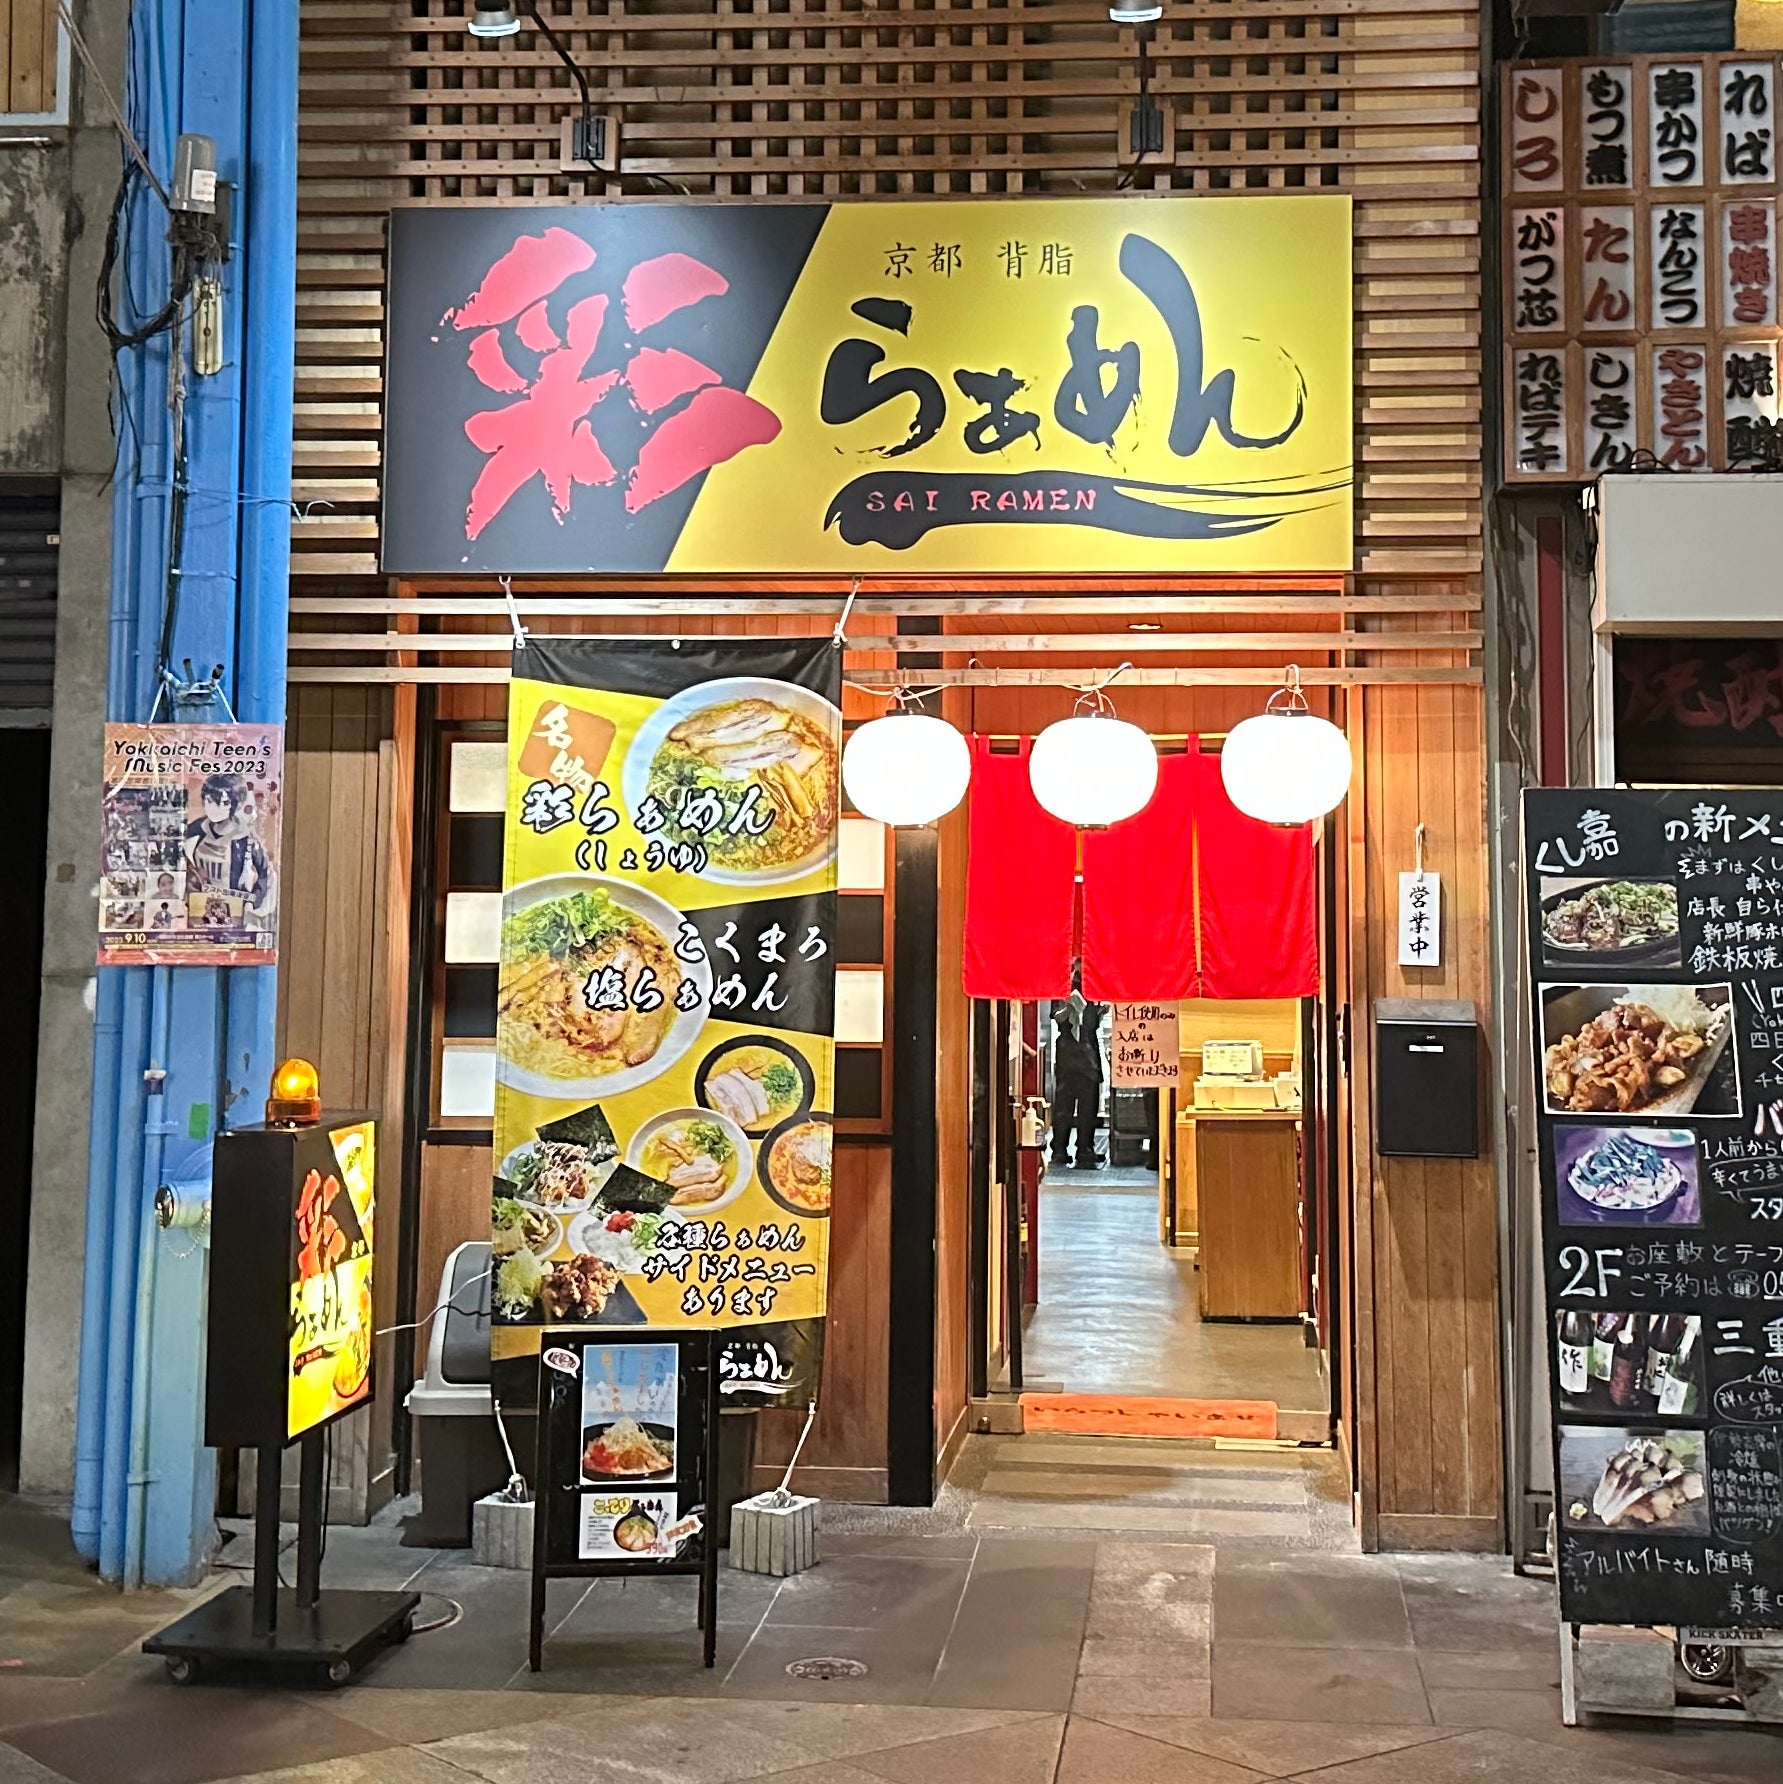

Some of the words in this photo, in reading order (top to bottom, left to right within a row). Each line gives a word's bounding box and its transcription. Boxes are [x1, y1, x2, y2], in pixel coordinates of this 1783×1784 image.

[1513, 78, 1558, 181] しろ
[1585, 70, 1627, 184] もつ煮
[1654, 69, 1696, 181] 串かつ
[1724, 69, 1770, 177] れば
[884, 241, 962, 278] 京都
[996, 240, 1077, 278] 背脂
[1518, 212, 1559, 327] がつ芯
[1583, 218, 1629, 322] たん
[1660, 210, 1698, 324] なんこつ
[1729, 206, 1769, 322] 串焼き
[431, 226, 782, 558] 彩
[820, 232, 1306, 461] らぁめん
[1519, 353, 1561, 470] ればテキ
[1591, 353, 1632, 468] しきん
[1659, 350, 1705, 467] やきとん
[865, 489, 940, 514] SAI
[969, 488, 1098, 514] RAMEN
[189, 757, 221, 773] Fes
[224, 760, 266, 773] 2023
[521, 781, 777, 834] 彩らぁめん
[674, 920, 828, 963] こくまろ
[1409, 886, 1430, 959] 営業中
[1687, 897, 1726, 918] 店長
[582, 966, 789, 1013] 塩らぁめん
[641, 1253, 815, 1283] サイドメニュー
[681, 1285, 777, 1316] あります
[1559, 1246, 1623, 1297] 2F
[1576, 1547, 1700, 1577] アルバイトさん
